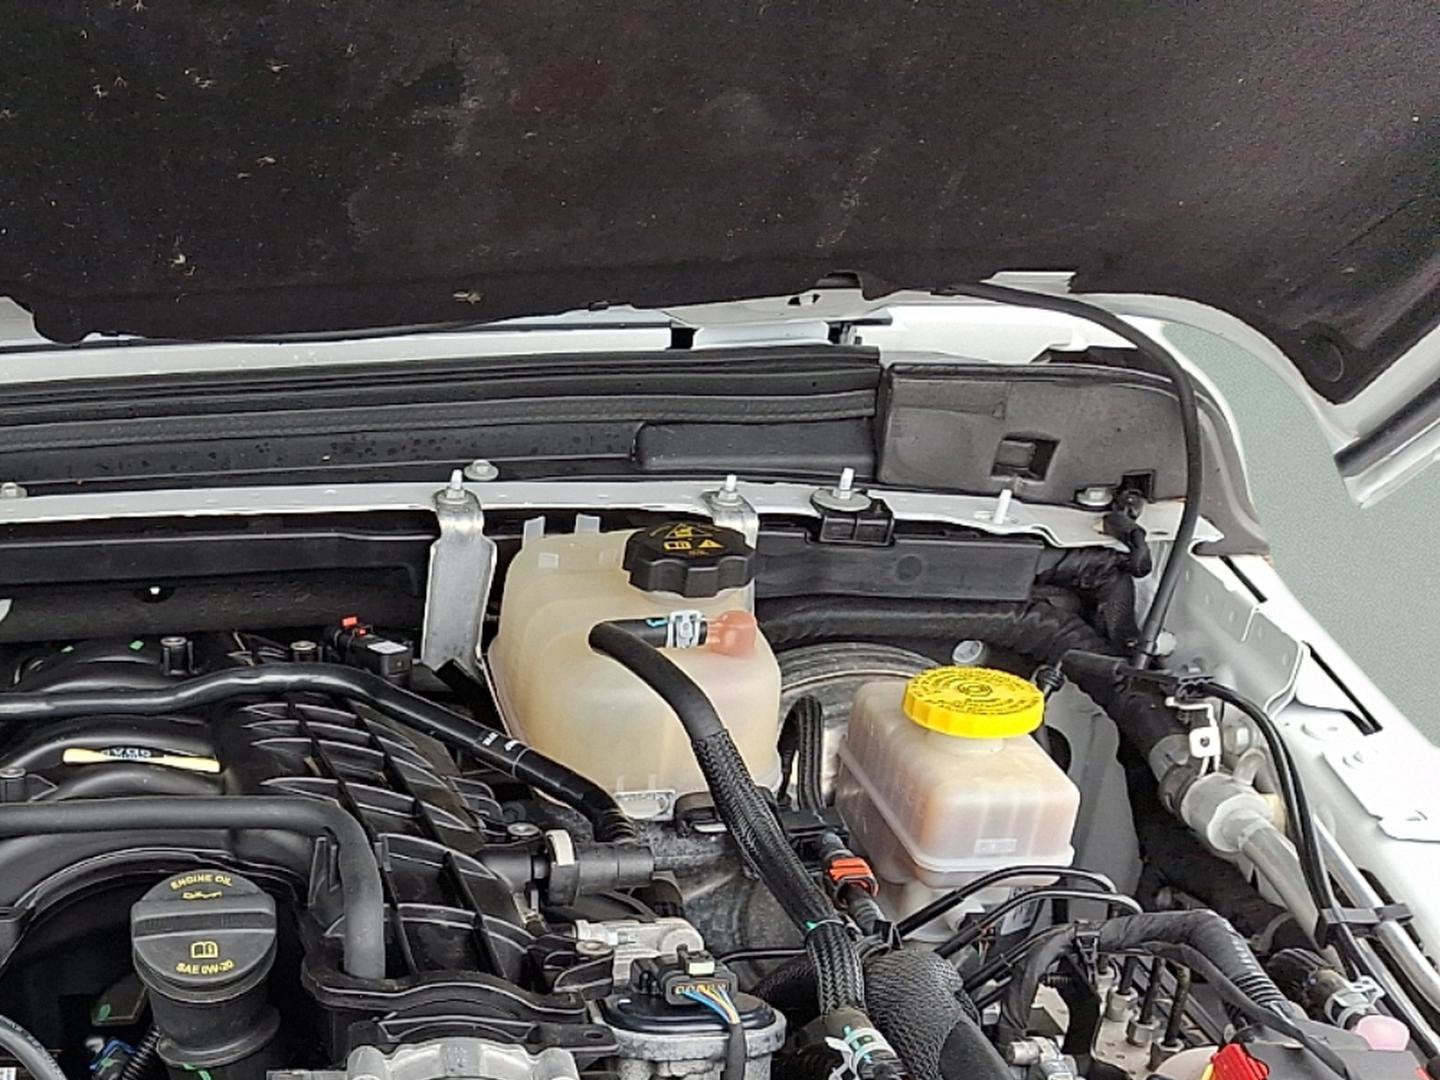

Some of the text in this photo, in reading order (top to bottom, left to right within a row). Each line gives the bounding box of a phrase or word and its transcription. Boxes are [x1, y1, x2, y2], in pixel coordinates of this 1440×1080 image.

[170, 874, 233, 890] ENGINE OIL
[176, 960, 234, 974] SAE 0W-20
